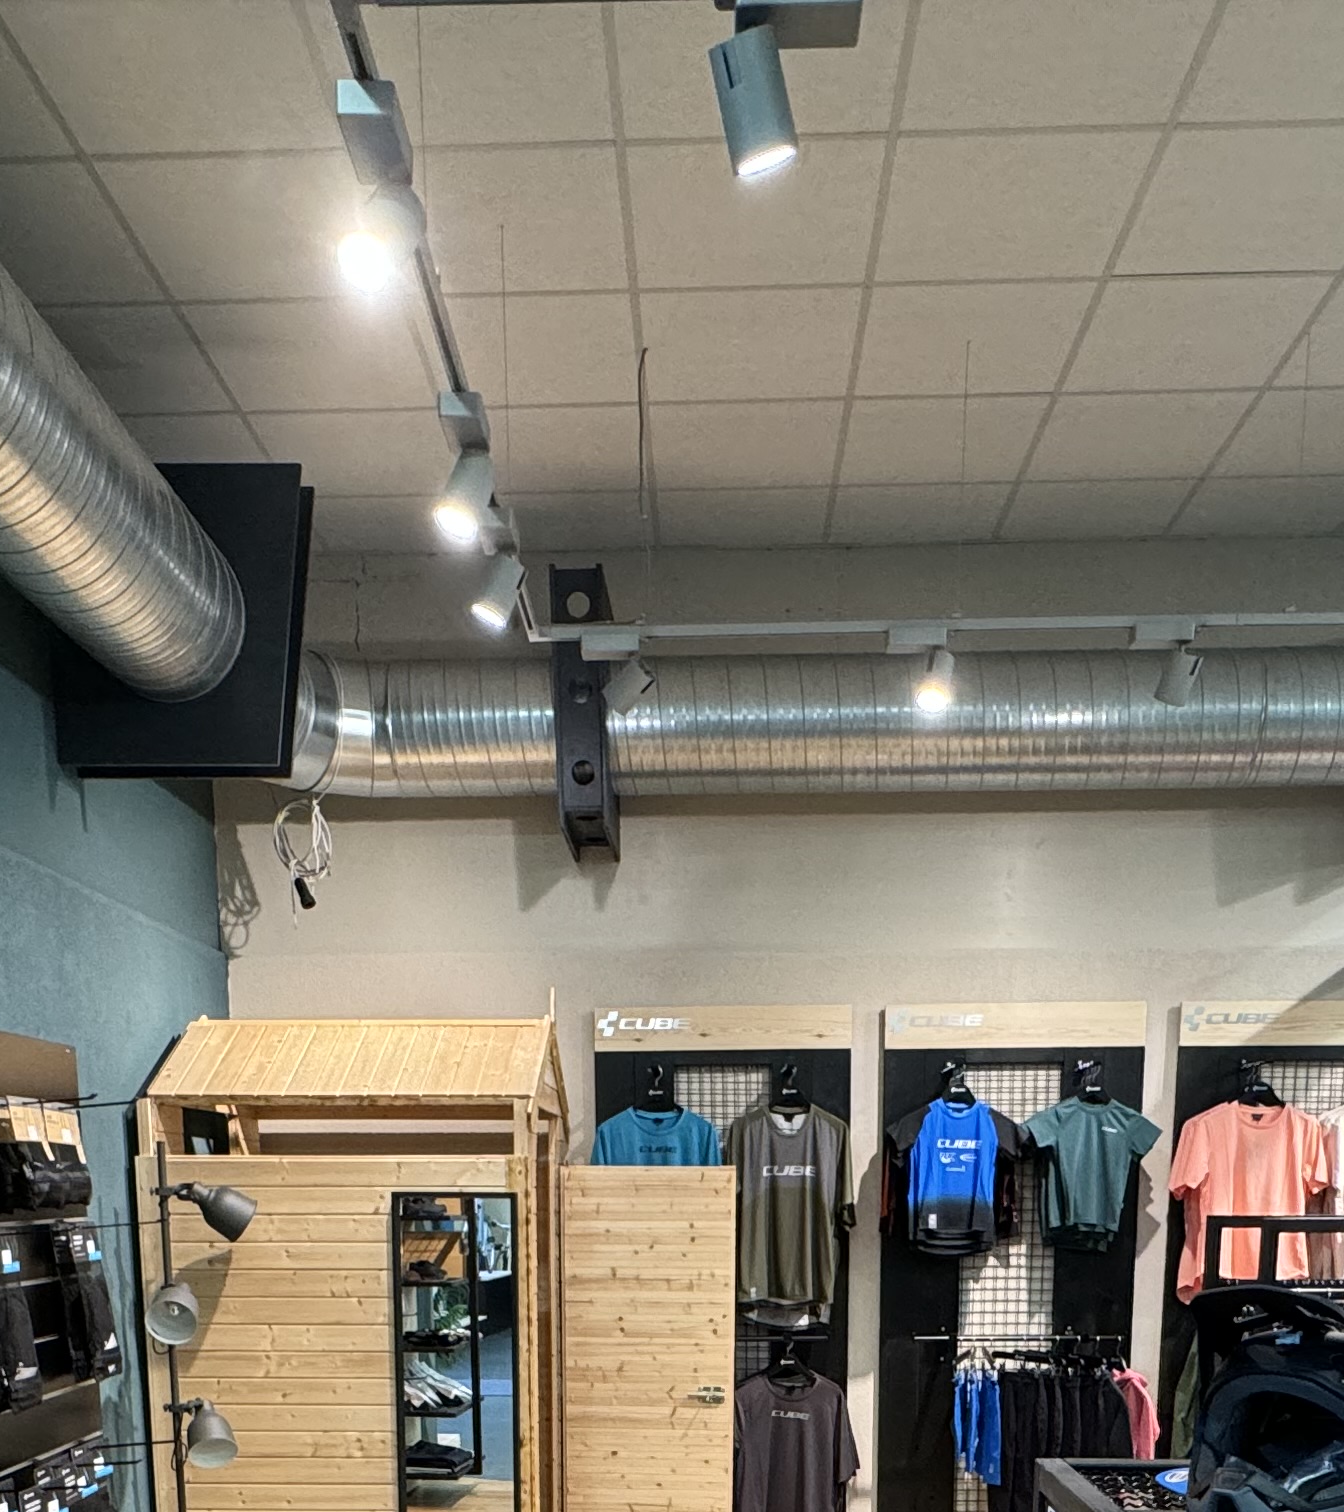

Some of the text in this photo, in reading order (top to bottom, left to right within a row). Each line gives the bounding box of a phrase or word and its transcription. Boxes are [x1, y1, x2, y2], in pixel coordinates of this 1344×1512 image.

[619, 1017, 692, 1030] CUBE
[909, 1014, 985, 1028] CUBE
[1205, 1012, 1281, 1025] CUBE
[762, 1165, 817, 1178] CUBE
[771, 1410, 811, 1421] CUBE
